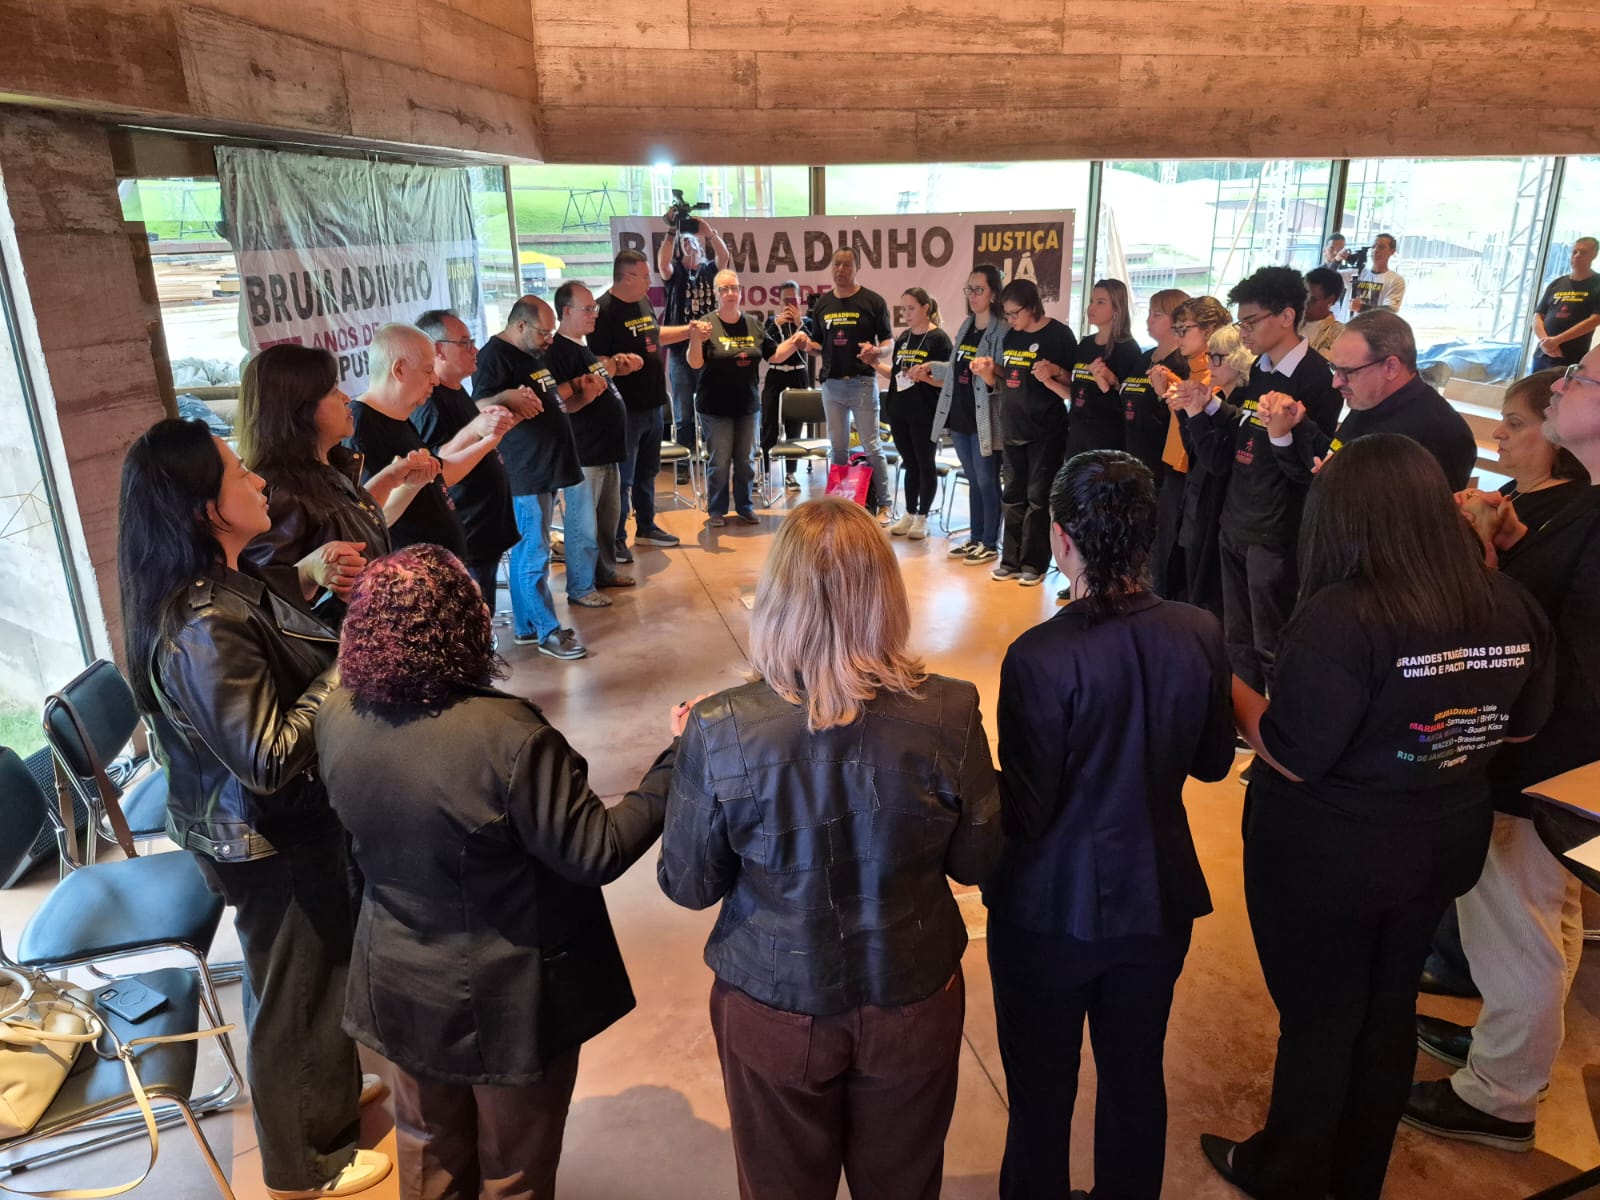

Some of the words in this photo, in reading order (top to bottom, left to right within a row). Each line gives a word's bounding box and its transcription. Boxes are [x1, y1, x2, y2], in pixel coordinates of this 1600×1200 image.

[619, 226, 954, 273] BMADNHO
[977, 229, 1060, 254] JUSTIÇA
[1002, 251, 1038, 288] JÁ
[245, 260, 432, 327] BRUMADINHO
[312, 326, 359, 353] ANOS
[1239, 409, 1252, 427] 7
[1396, 653, 1443, 668] GRANDES
[1443, 646, 1487, 661] TRAGÉDIAS
[1488, 646, 1503, 656] DO
[1504, 643, 1531, 655] BRASIL
[1403, 665, 1437, 678] UNIÃO
[1438, 665, 1444, 675] E
[1444, 661, 1465, 674] PACTO
[1466, 659, 1488, 670] POR
[1488, 656, 1525, 669] JUSTIÇA
[1397, 750, 1415, 762] RIO
